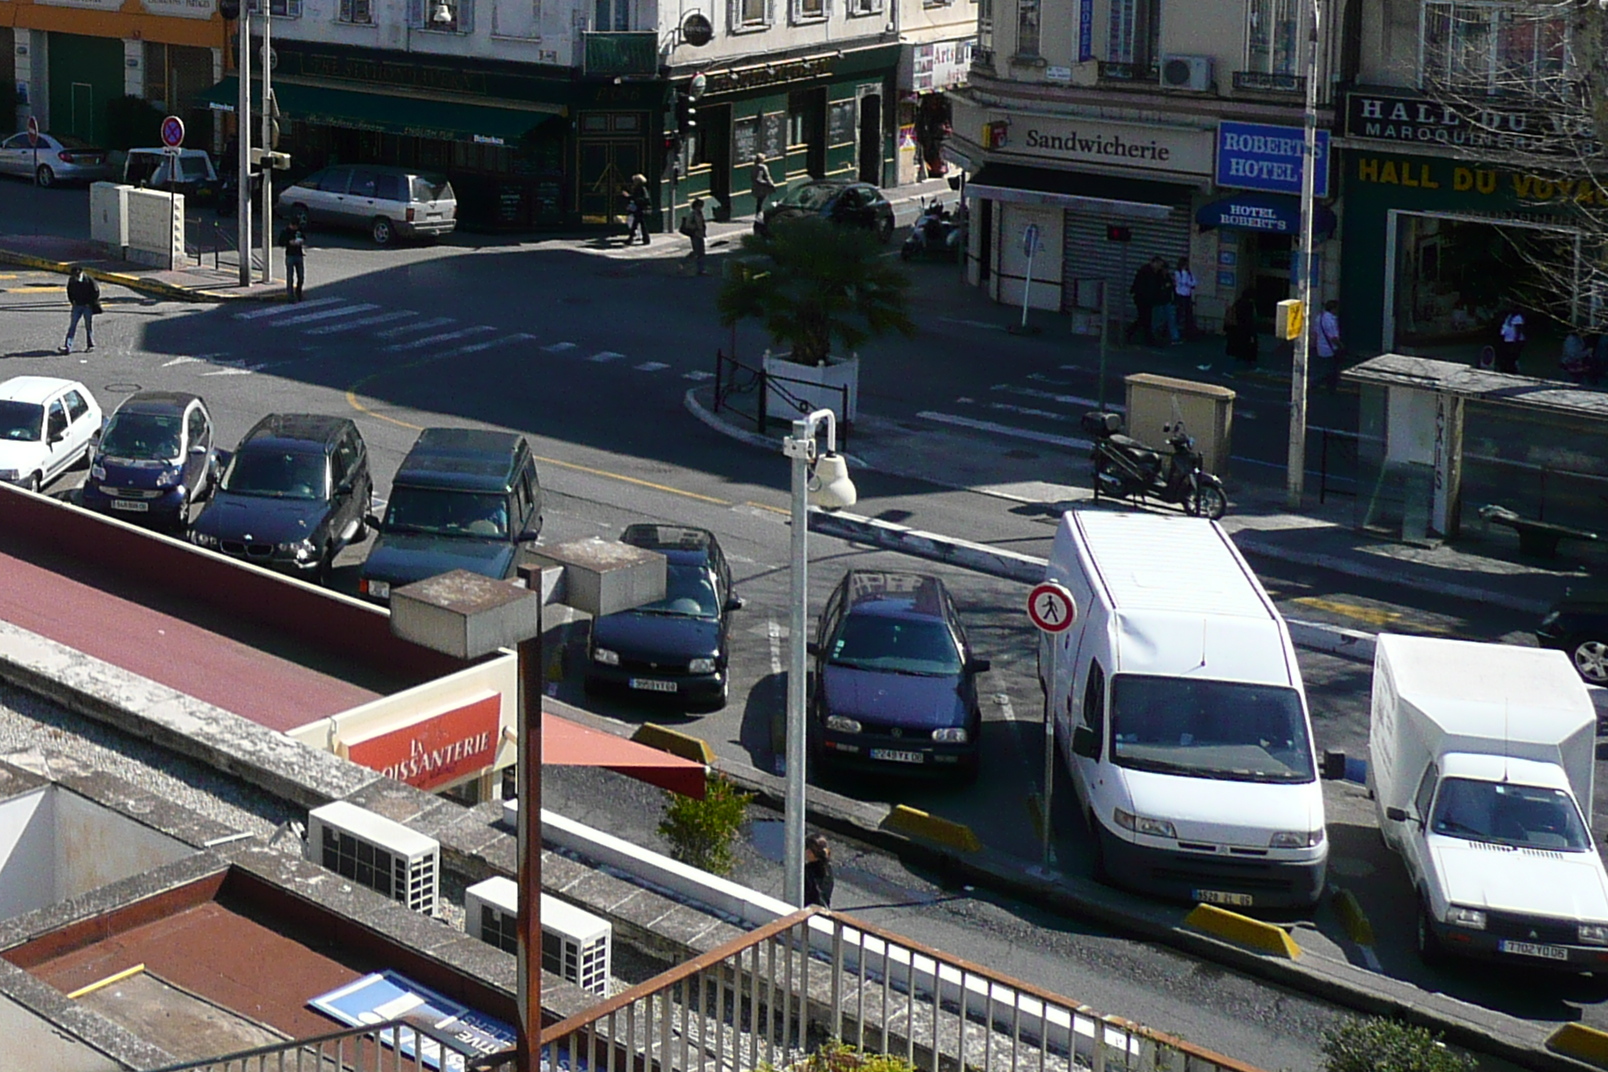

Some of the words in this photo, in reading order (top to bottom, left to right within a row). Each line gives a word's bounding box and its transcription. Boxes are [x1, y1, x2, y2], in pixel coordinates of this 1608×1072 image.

[1079, 2, 1092, 57] HOTEL
[1361, 100, 1459, 126] HALL
[1482, 110, 1526, 132] DU
[1026, 129, 1170, 161] Sandwicherie
[1229, 158, 1298, 182] HOTEL
[1359, 159, 1440, 189] HALL
[1453, 166, 1497, 195] DU
[1220, 214, 1287, 231] ROBERT'S
[1229, 204, 1277, 219] HOTEL
[411, 738, 424, 758] LA
